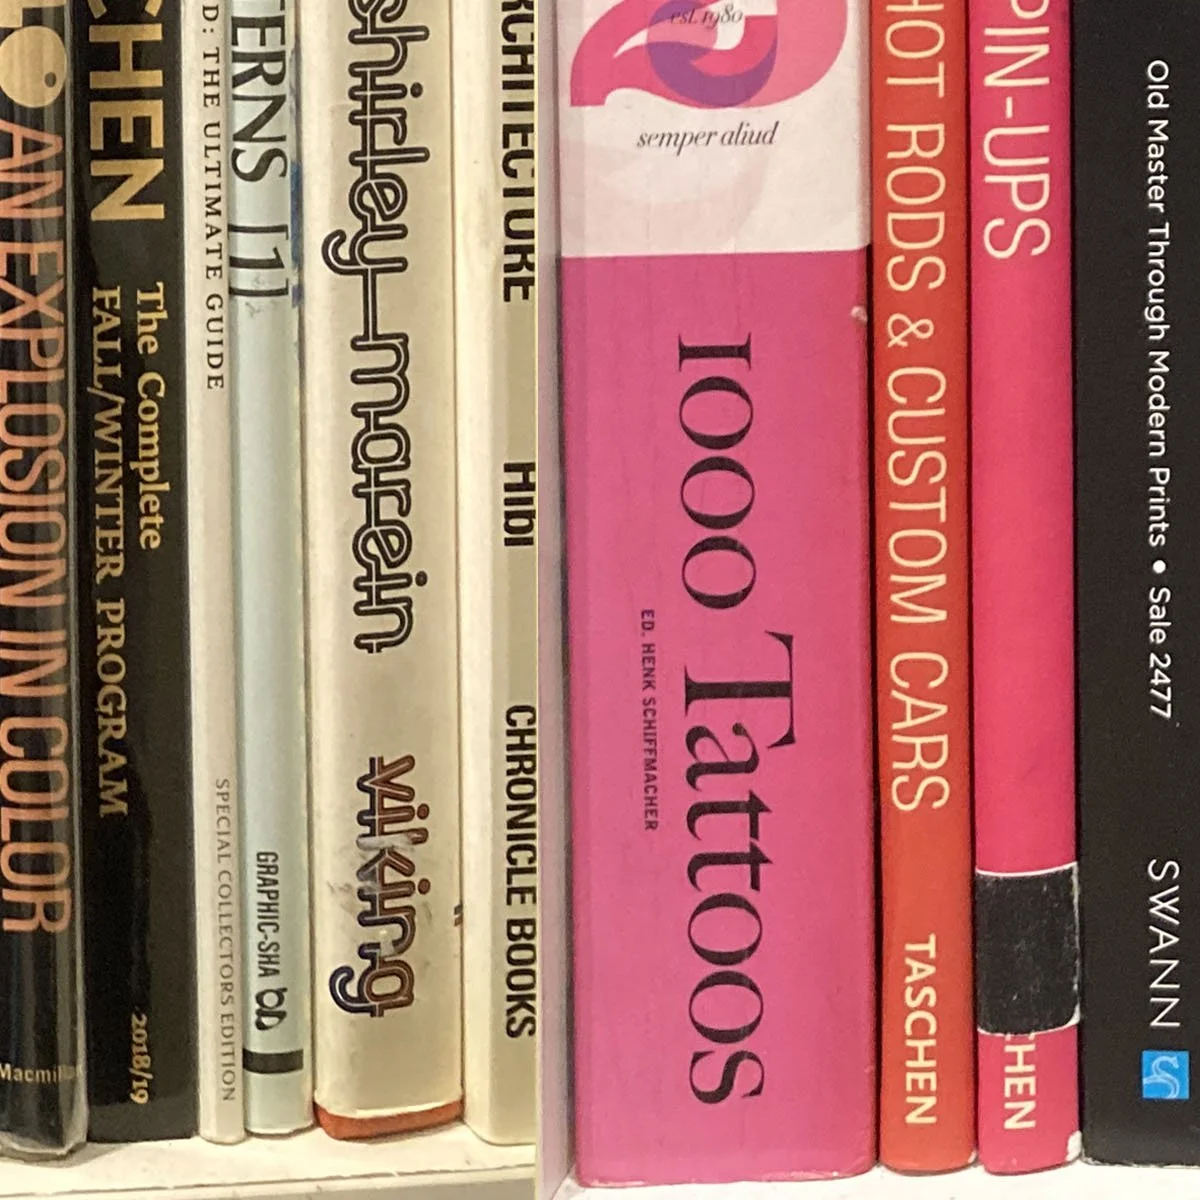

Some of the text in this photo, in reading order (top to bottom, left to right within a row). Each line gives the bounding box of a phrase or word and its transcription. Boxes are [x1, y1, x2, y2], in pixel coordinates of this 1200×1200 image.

[202, 47, 221, 109] THE
[700, 2, 744, 30] 1980
[203, 121, 223, 280] ULTIMATE
[636, 120, 780, 157] semper aliud
[886, 122, 947, 292] RODS
[205, 293, 226, 391] GUIDE
[229, 222, 289, 298] [1]
[886, 311, 936, 349] &
[129, 280, 168, 551] The Complete
[1144, 59, 1173, 719] Old Master Through Modern Prints Sale 2477
[0, 124, 74, 934] AN EXPLOSION IN COLOR
[886, 366, 948, 625] CUSTOM
[87, 286, 149, 1105] FALL/WINTER PROGRAM 2018/19
[639, 608, 659, 834] ED. HENK SCHIFFMACHER
[889, 651, 951, 812] CARS
[214, 777, 237, 1103] SPECIAL COLLECTORS EDITION
[255, 851, 282, 978] GRAPHIC-SHA
[329, 754, 431, 1018] viking
[504, 704, 538, 1039] CHRONICLE BOOKS
[683, 629, 798, 1105] Tattoos
[1145, 859, 1180, 1031] SWANN
[904, 933, 938, 1125] TASCHEN
